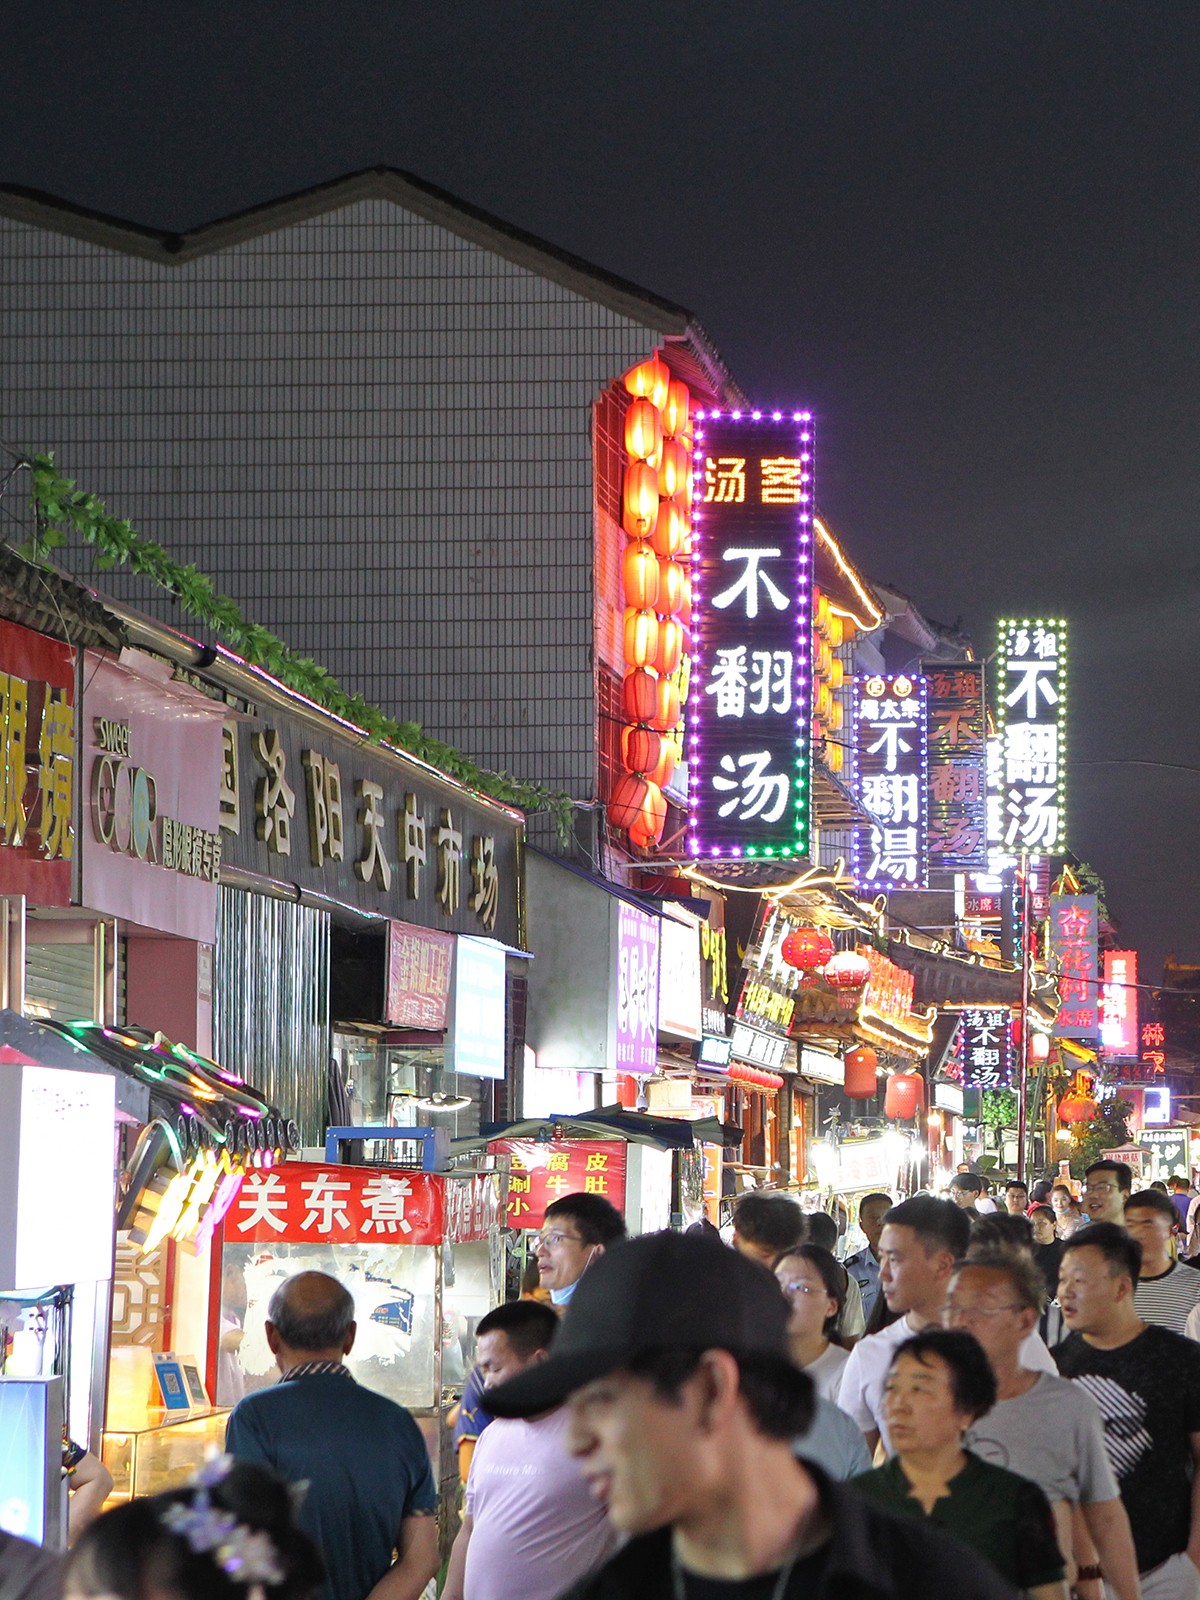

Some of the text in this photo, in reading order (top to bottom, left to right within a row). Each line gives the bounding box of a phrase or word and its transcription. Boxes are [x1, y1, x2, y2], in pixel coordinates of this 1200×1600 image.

[704, 457, 802, 503] 汤客
[705, 547, 795, 823] 不翻汤
[927, 708, 981, 855] 不翻汤
[1004, 661, 1058, 848] 不翻汤
[1057, 904, 1093, 1003] 杏花村
[1055, 1008, 1094, 1028] 水席
[969, 1027, 1001, 1085] 不翻汤
[508, 1174, 609, 1194] 涮牛肚
[509, 1152, 609, 1172] 豆腐皮
[236, 1174, 414, 1235] 关东煮
